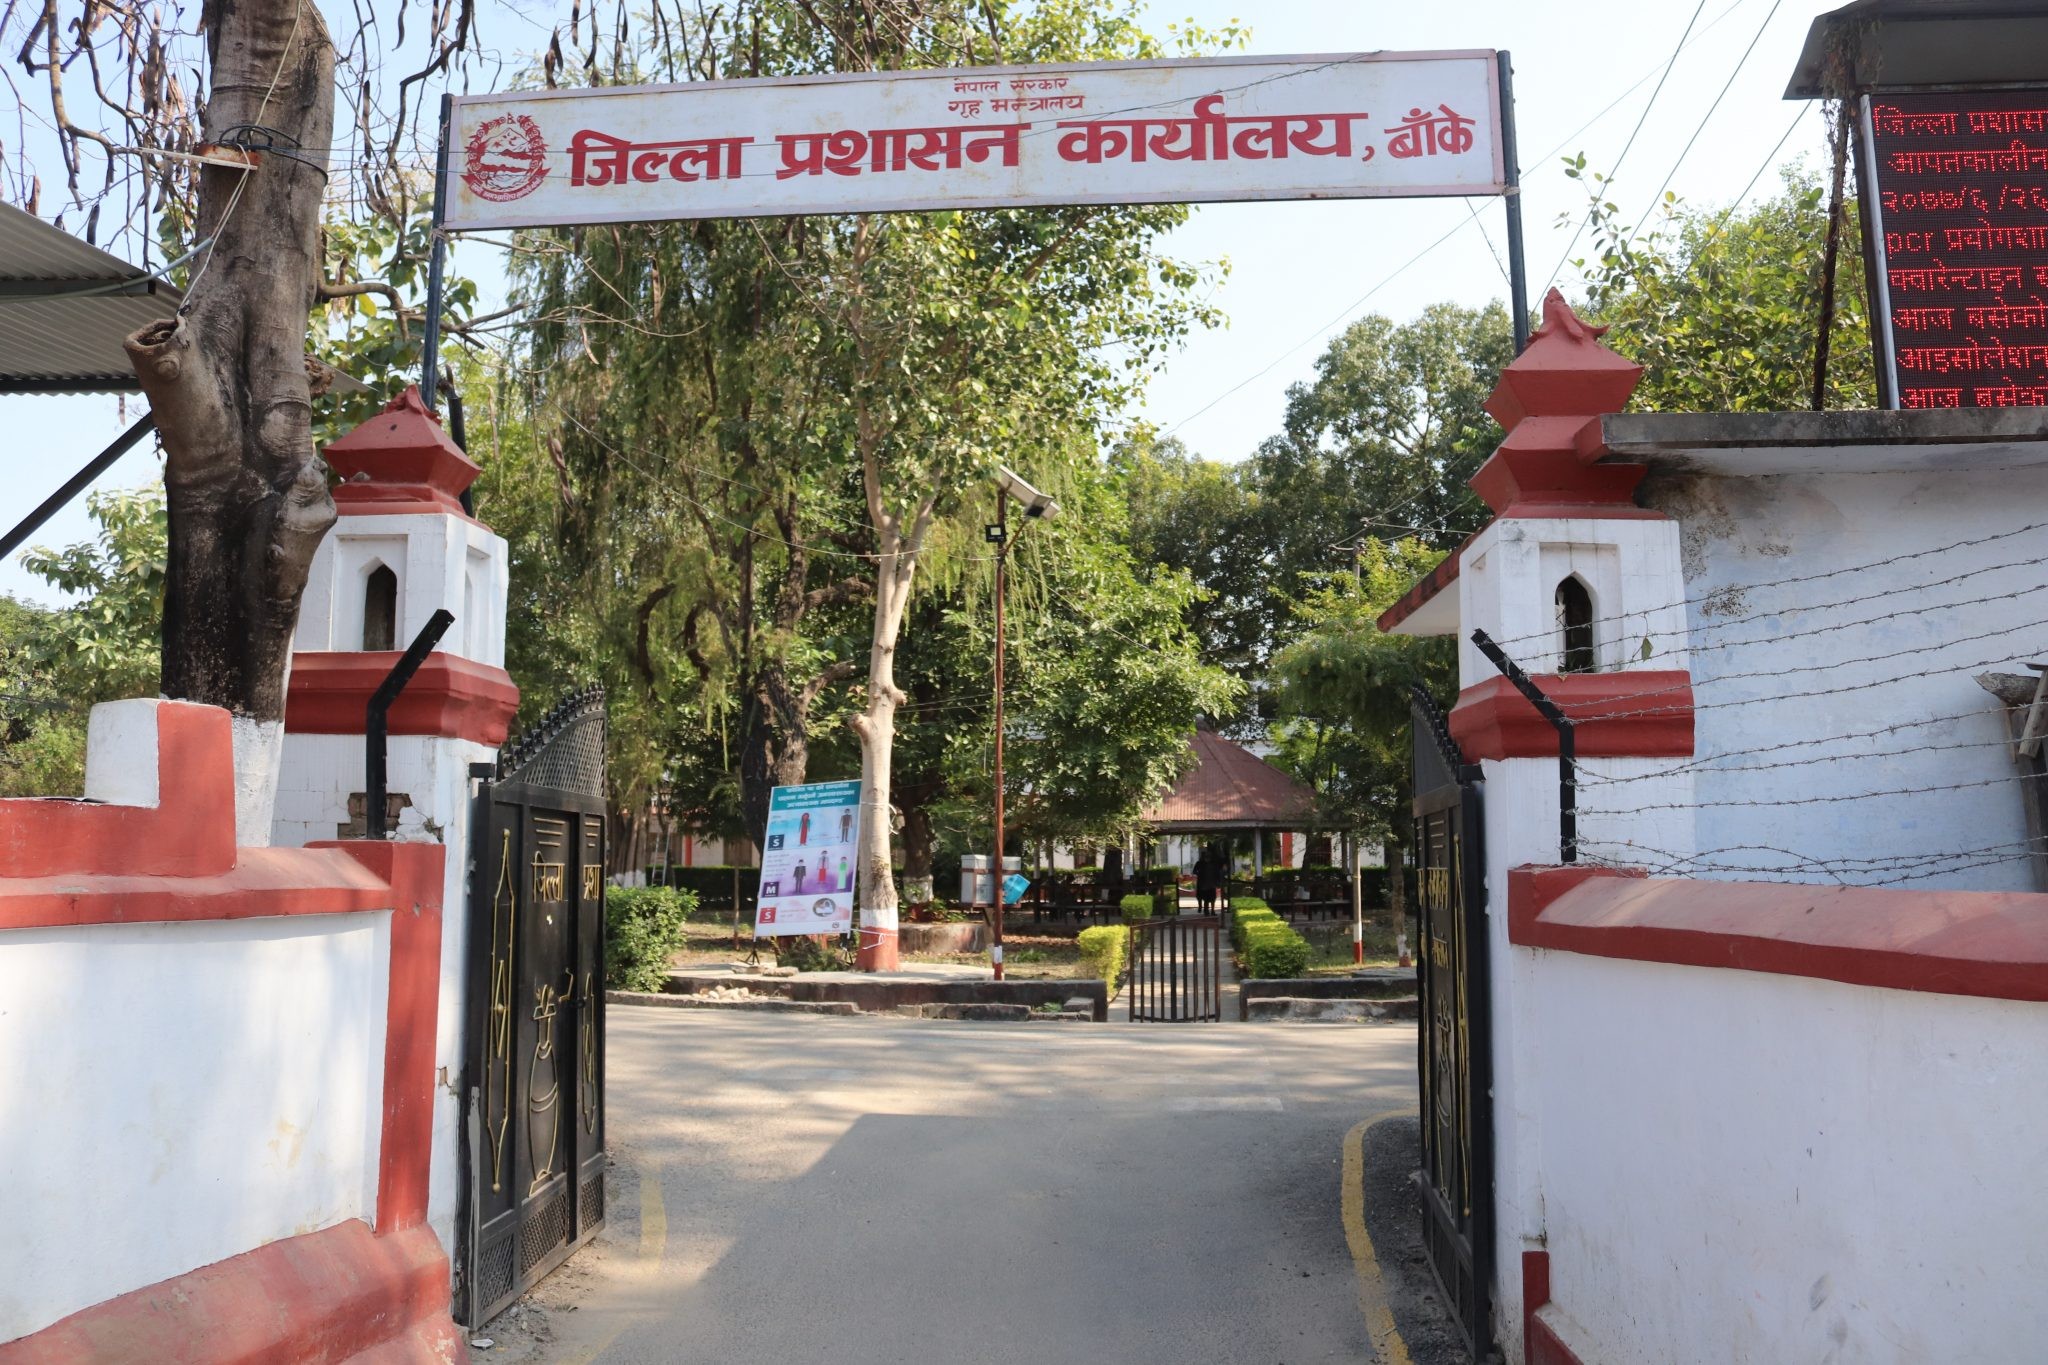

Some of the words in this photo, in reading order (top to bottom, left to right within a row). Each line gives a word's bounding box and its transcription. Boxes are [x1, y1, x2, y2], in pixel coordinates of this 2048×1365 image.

[953, 77, 1000, 94] नेपाल
[1009, 77, 1070, 93] सरकार
[947, 99, 983, 119] गृह
[990, 95, 1087, 113] मन्त्रालय
[1872, 104, 1959, 136] जिल्ला
[1966, 110, 2048, 134] प्रशास
[566, 129, 755, 187] जिल्ला
[776, 123, 1032, 180] प्रशासन
[1056, 94, 1374, 163] कार्यालय,
[1383, 103, 1476, 159] बाँके
[1887, 232, 1933, 260] pcr
[1944, 217, 2048, 251] प्रयोगशा
[1892, 307, 1955, 330] आज
[1900, 387, 1963, 409] आज
[772, 839, 780, 847] S
[766, 885, 776, 895] M
[764, 911, 772, 920] S
